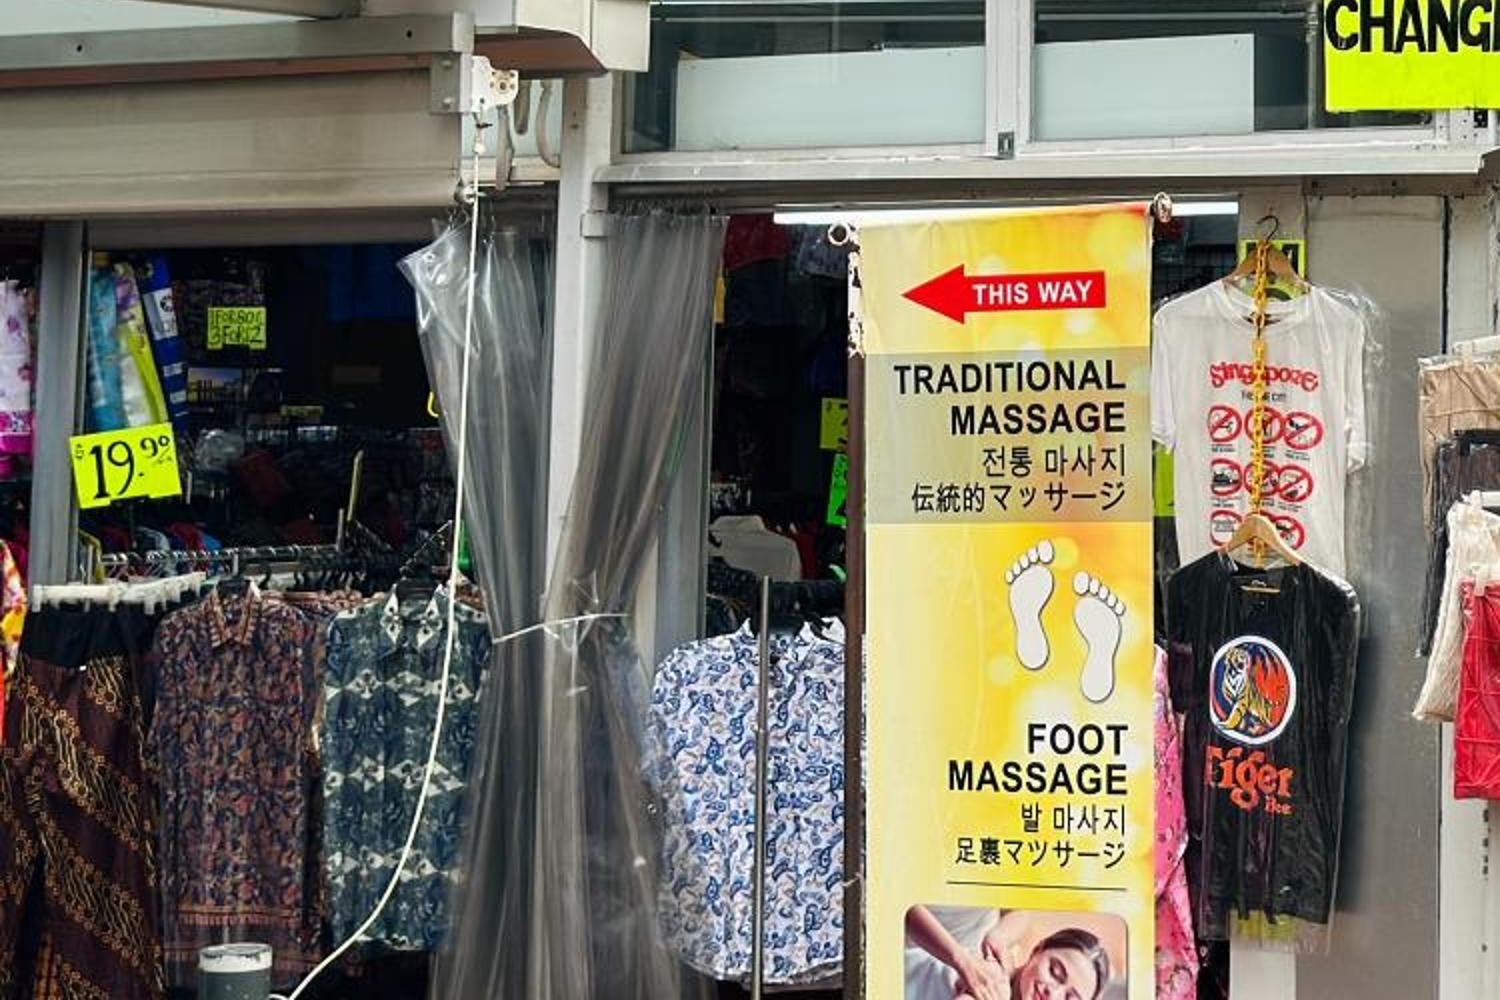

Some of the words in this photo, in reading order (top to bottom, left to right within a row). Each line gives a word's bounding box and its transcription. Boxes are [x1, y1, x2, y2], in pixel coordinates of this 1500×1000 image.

[972, 283, 1028, 304] THIS
[1039, 280, 1092, 302] WAY
[894, 360, 1126, 394] TRADITIONAL
[951, 402, 1126, 435] MASSAGE
[983, 447, 1032, 478] 전통
[1046, 444, 1126, 477] 마사지
[911, 481, 1126, 513] 伝統的マッサージ
[1028, 723, 1128, 755] FOOT
[948, 760, 1127, 794] MASSAGE
[1205, 745, 1293, 811] Tiger
[1022, 802, 1042, 832] 발
[1053, 802, 1125, 835] 마사지
